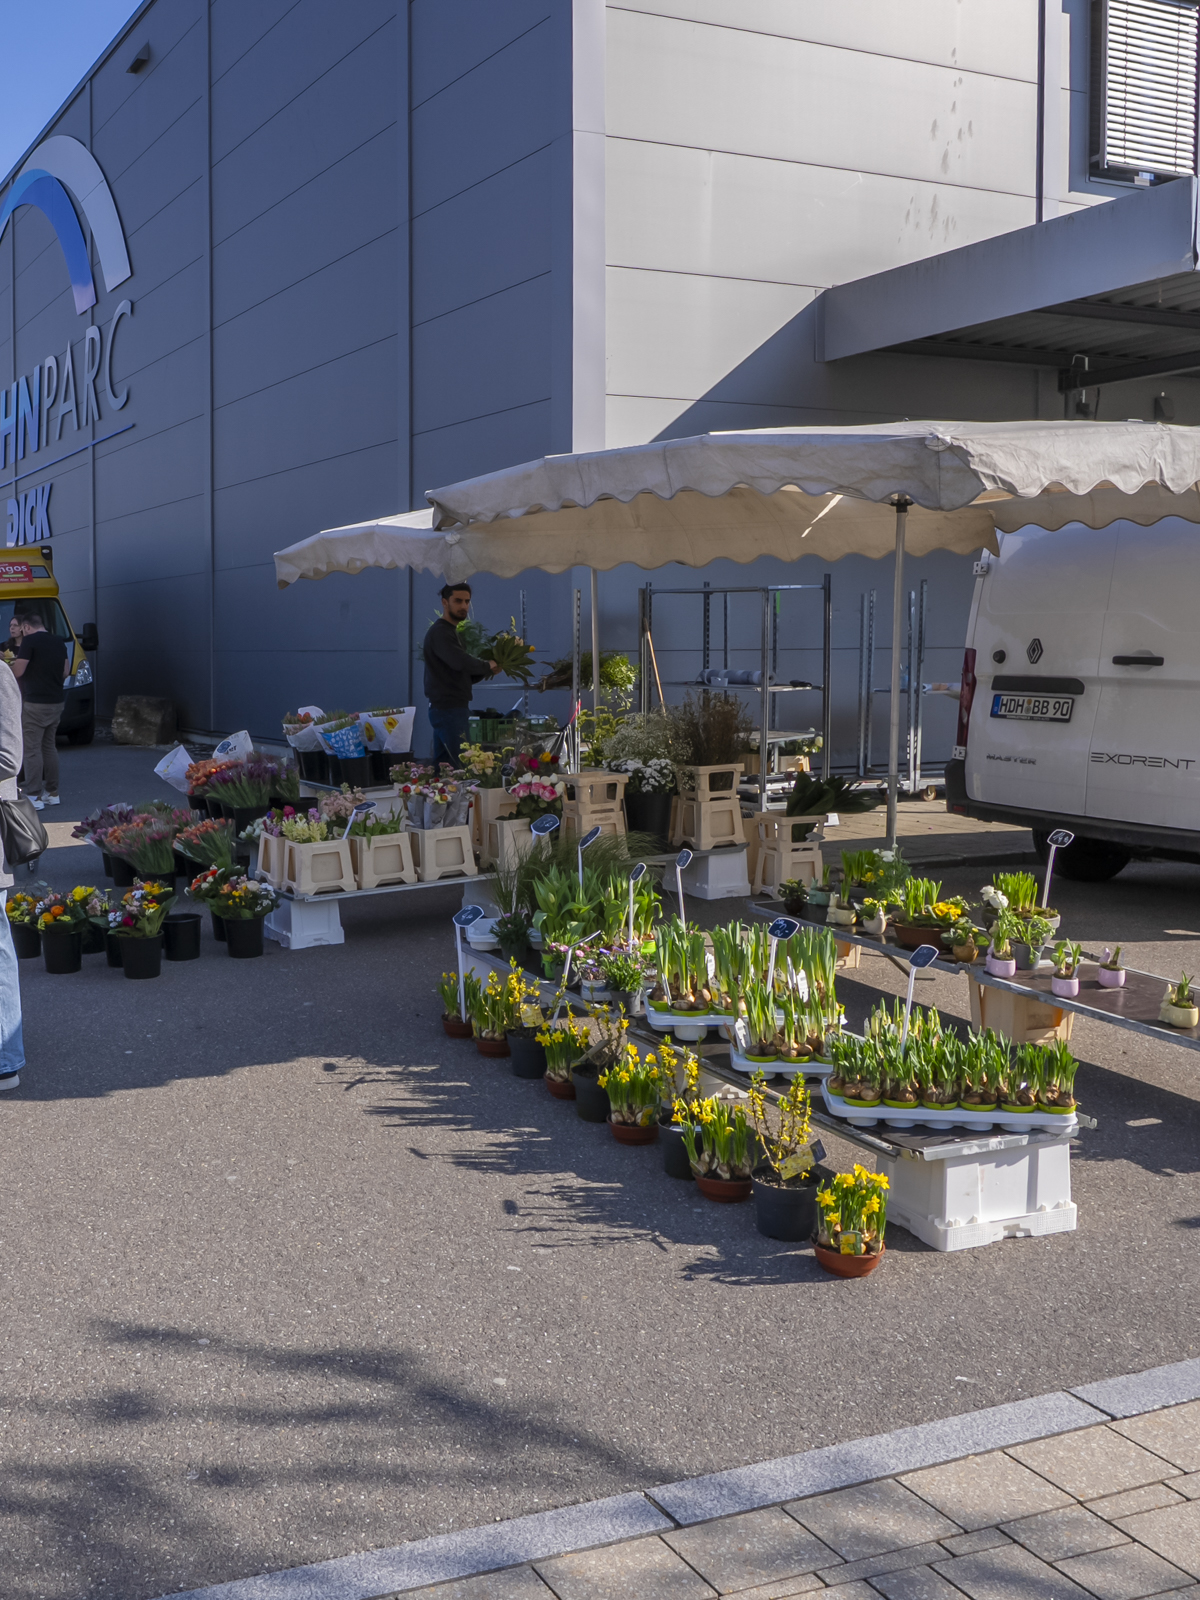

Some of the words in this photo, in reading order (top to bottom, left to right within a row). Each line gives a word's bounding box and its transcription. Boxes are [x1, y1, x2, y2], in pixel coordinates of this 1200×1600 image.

[6, 483, 53, 548] DICK
[999, 698, 1026, 714] HDH
[1031, 699, 1050, 716] BB
[1052, 701, 1070, 717] 90
[986, 753, 1037, 766] MASTER
[1090, 751, 1197, 770] EXORENT
